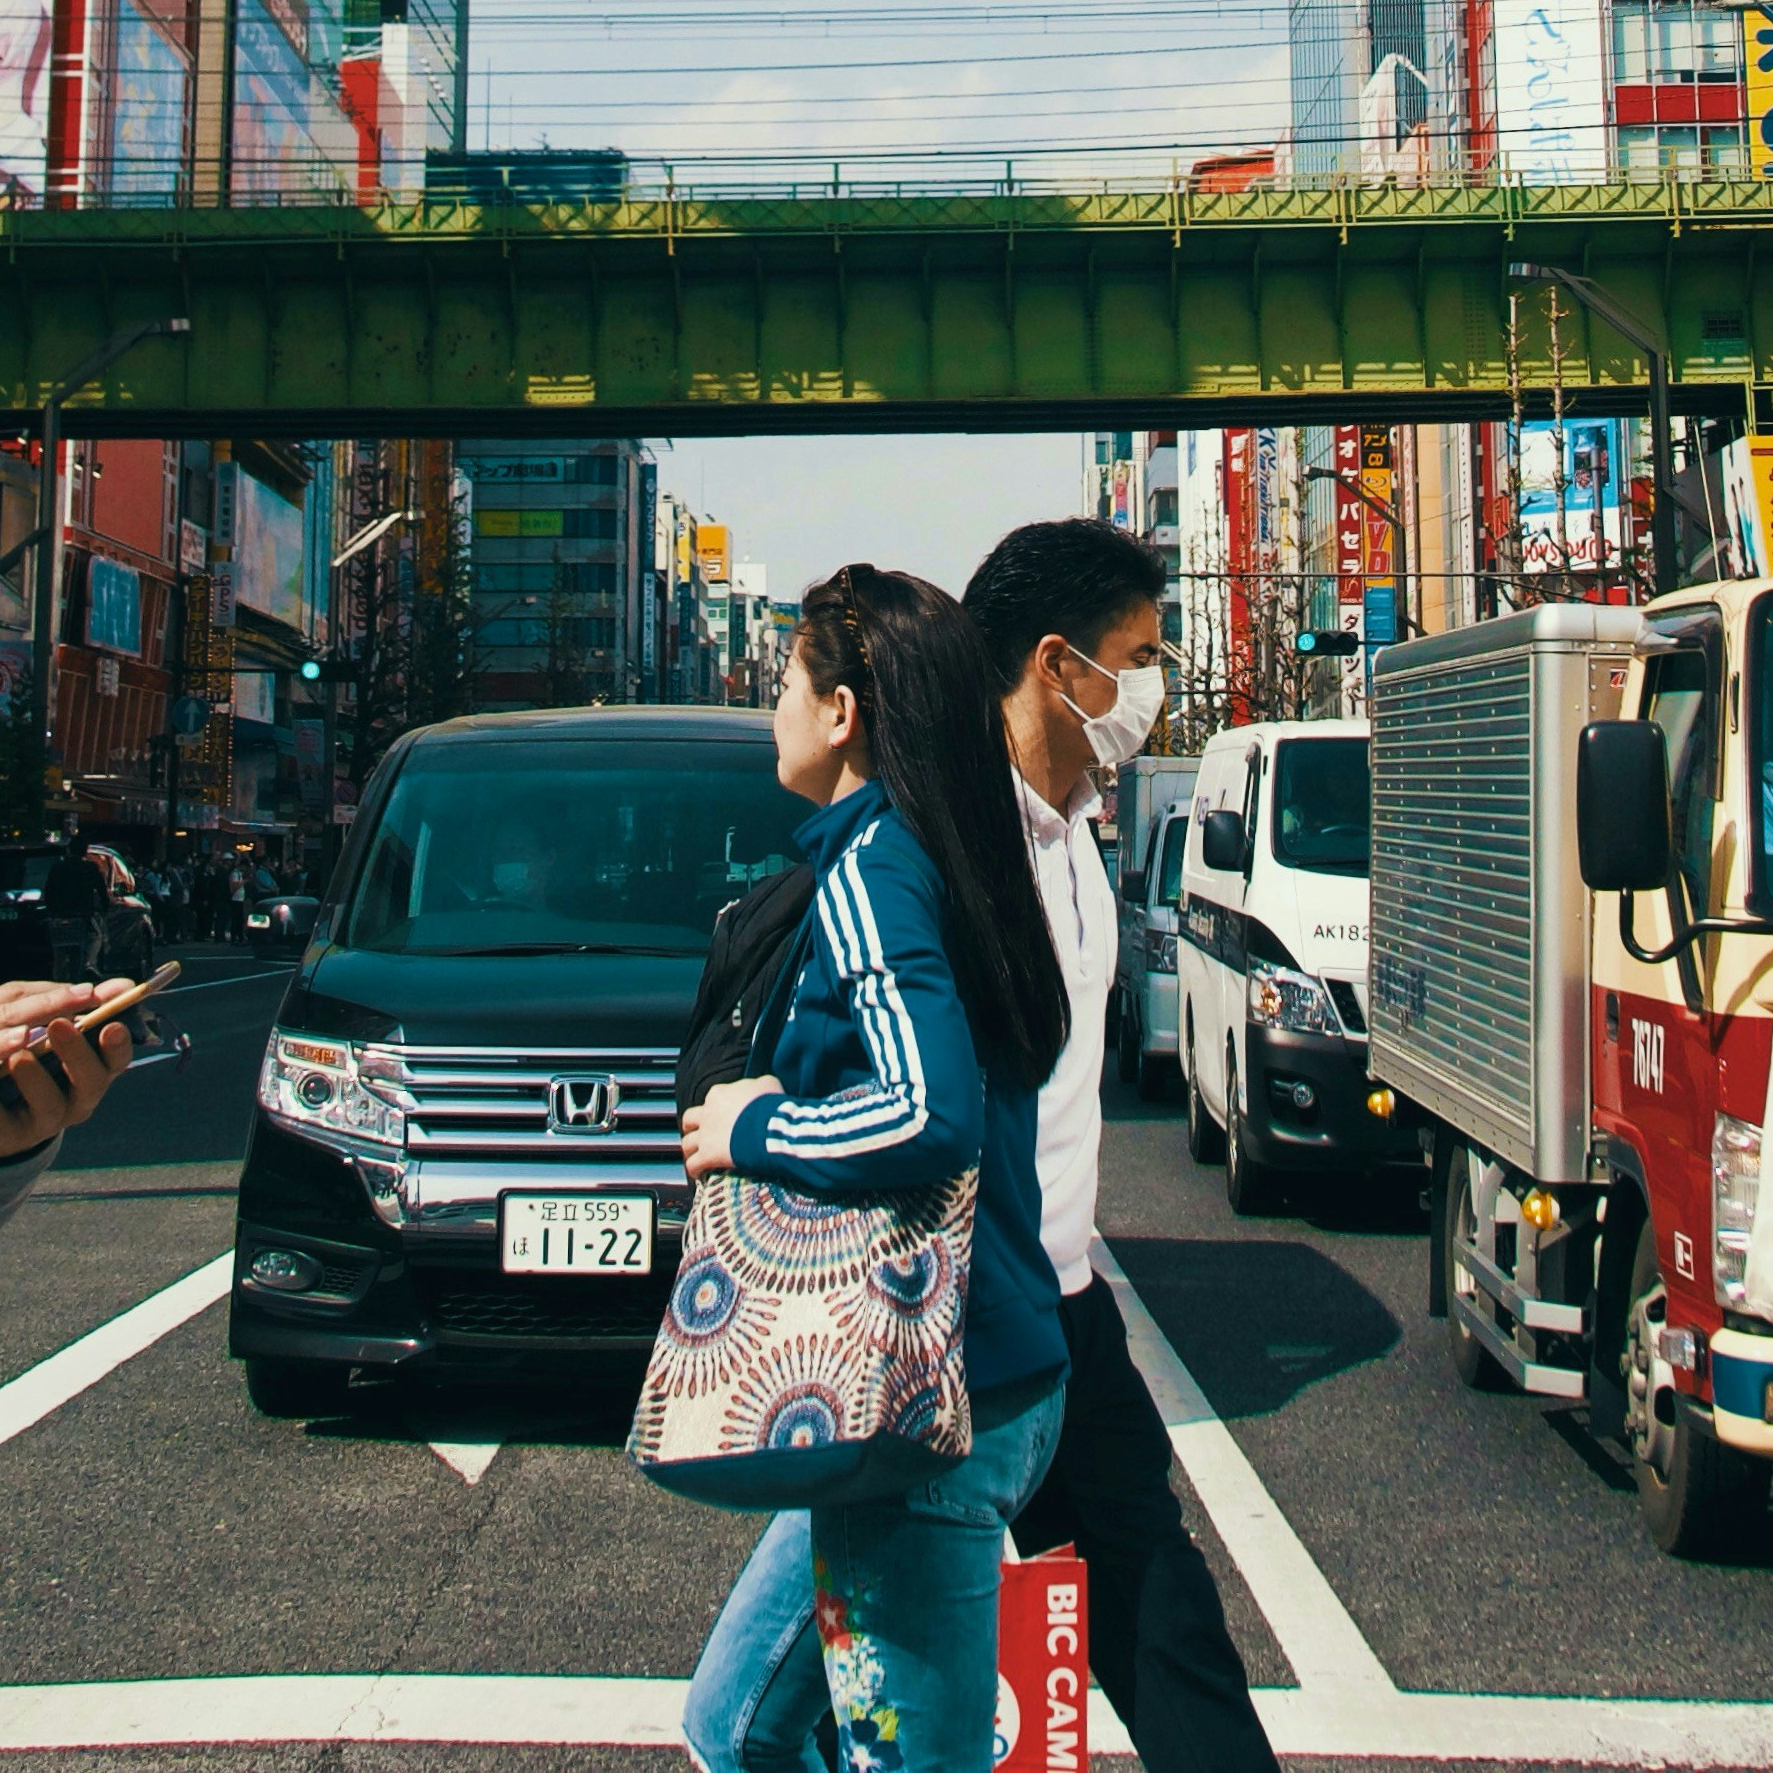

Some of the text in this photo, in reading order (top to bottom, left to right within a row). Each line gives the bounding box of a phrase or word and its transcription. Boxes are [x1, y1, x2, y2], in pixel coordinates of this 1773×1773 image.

[1339, 425, 1362, 575] オケパセラ
[540, 1200, 621, 1222] 足立 559
[512, 1227, 643, 1267] ほ 11-22
[1047, 1583, 1079, 1658] BIC
